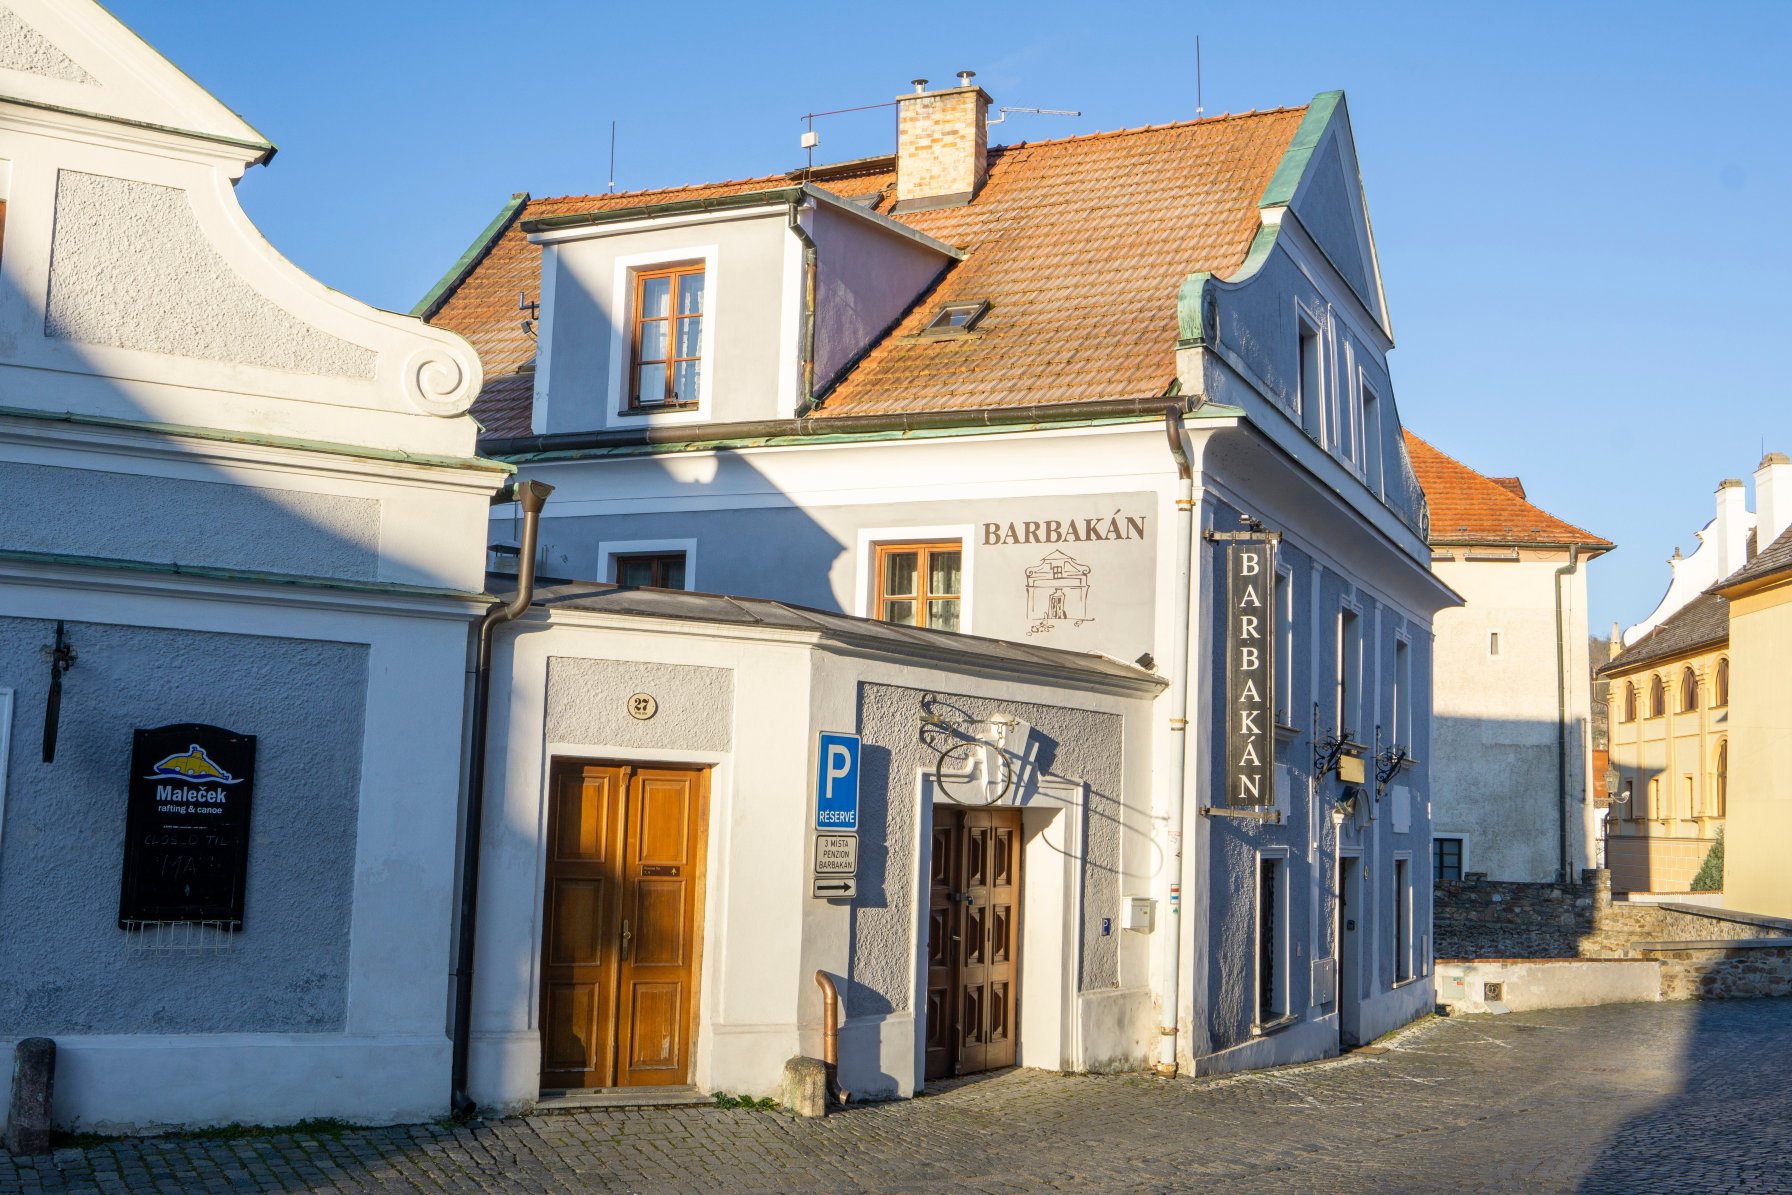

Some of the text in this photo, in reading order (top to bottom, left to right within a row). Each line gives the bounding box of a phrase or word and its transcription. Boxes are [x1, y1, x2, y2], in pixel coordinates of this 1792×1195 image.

[982, 508, 1147, 546] BARBAKÁN
[1238, 553, 1262, 798] BARBAKÁN
[634, 697, 650, 711] 27
[826, 744, 851, 798] P
[156, 785, 226, 803] Maleček
[158, 804, 223, 814] rafting & canoe
[819, 808, 855, 823] RÉSERVÉ
[824, 838, 849, 848] 3 MÍSTA
[823, 850, 850, 859] PENZION
[818, 859, 853, 869] BARBAKÁN
